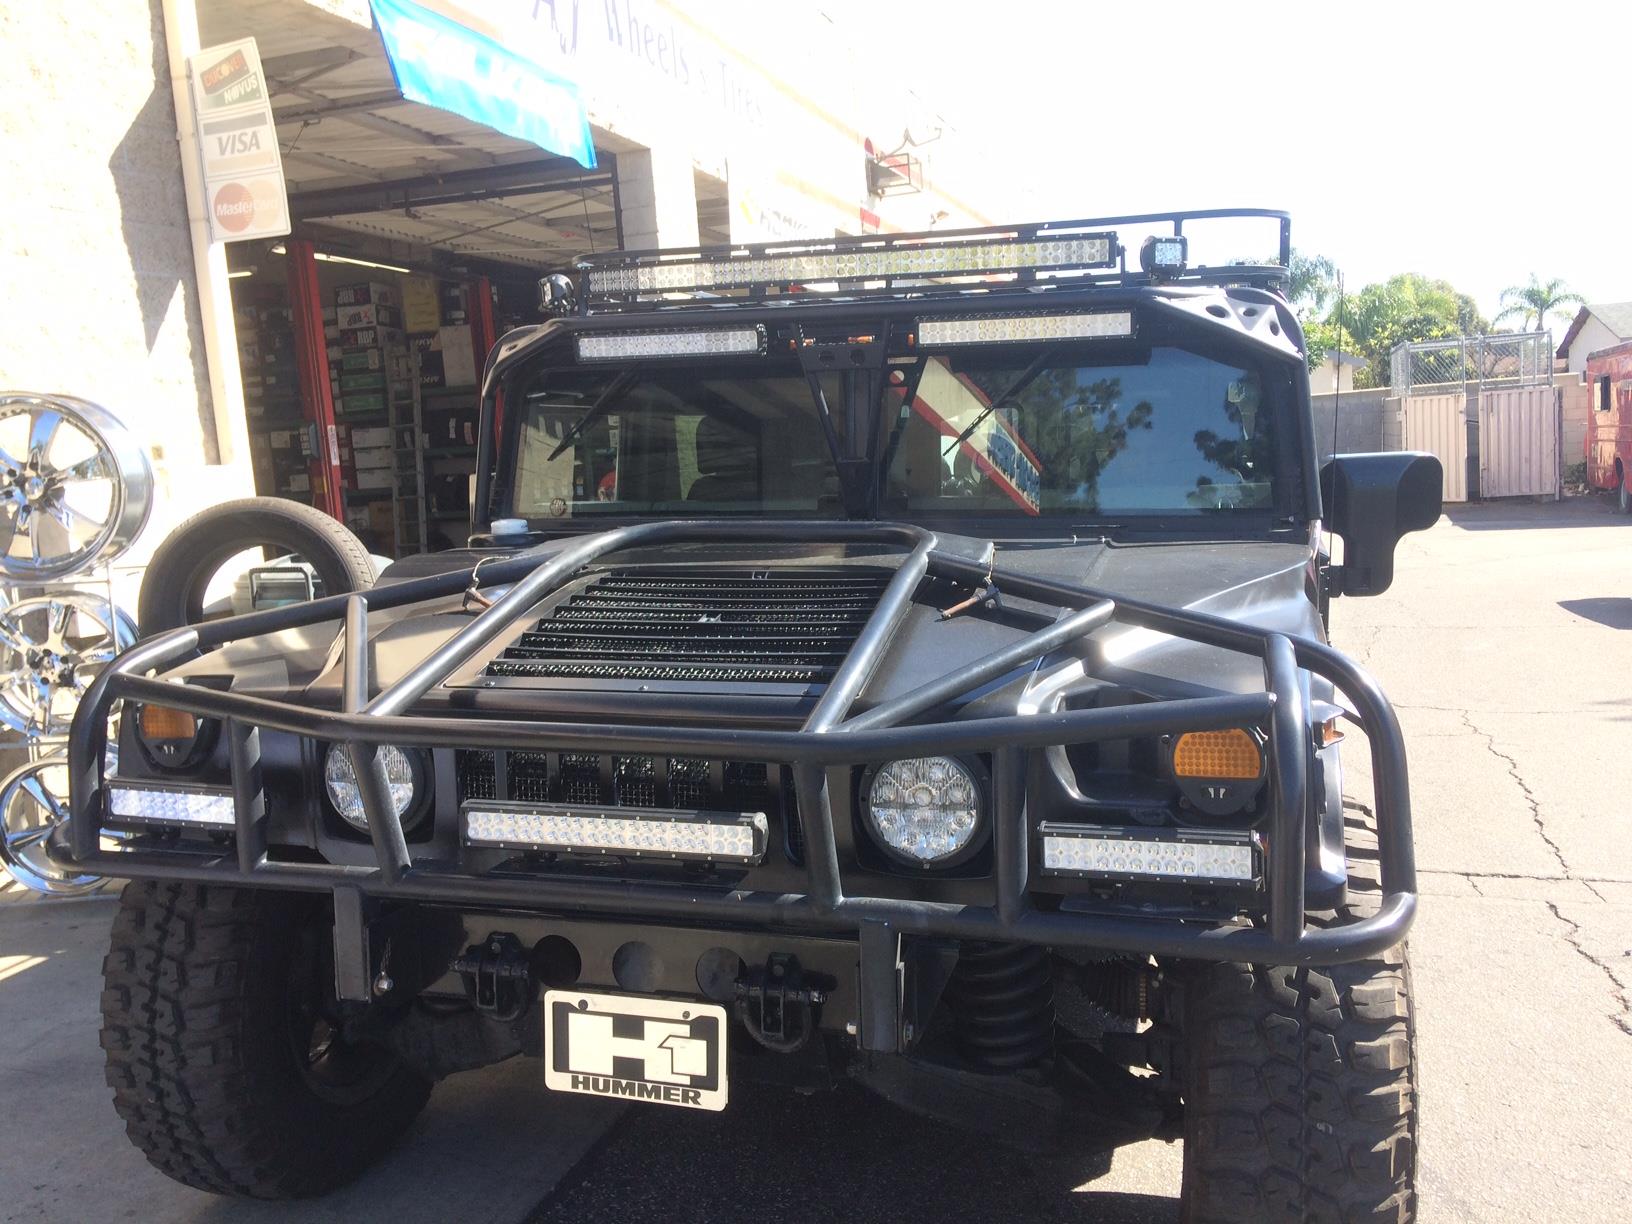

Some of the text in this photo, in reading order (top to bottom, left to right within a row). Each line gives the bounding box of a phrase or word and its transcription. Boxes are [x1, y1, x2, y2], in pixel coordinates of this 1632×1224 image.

[217, 130, 261, 156] VISA
[568, 1012, 708, 1086] H1
[571, 1074, 703, 1106] HUMMER
